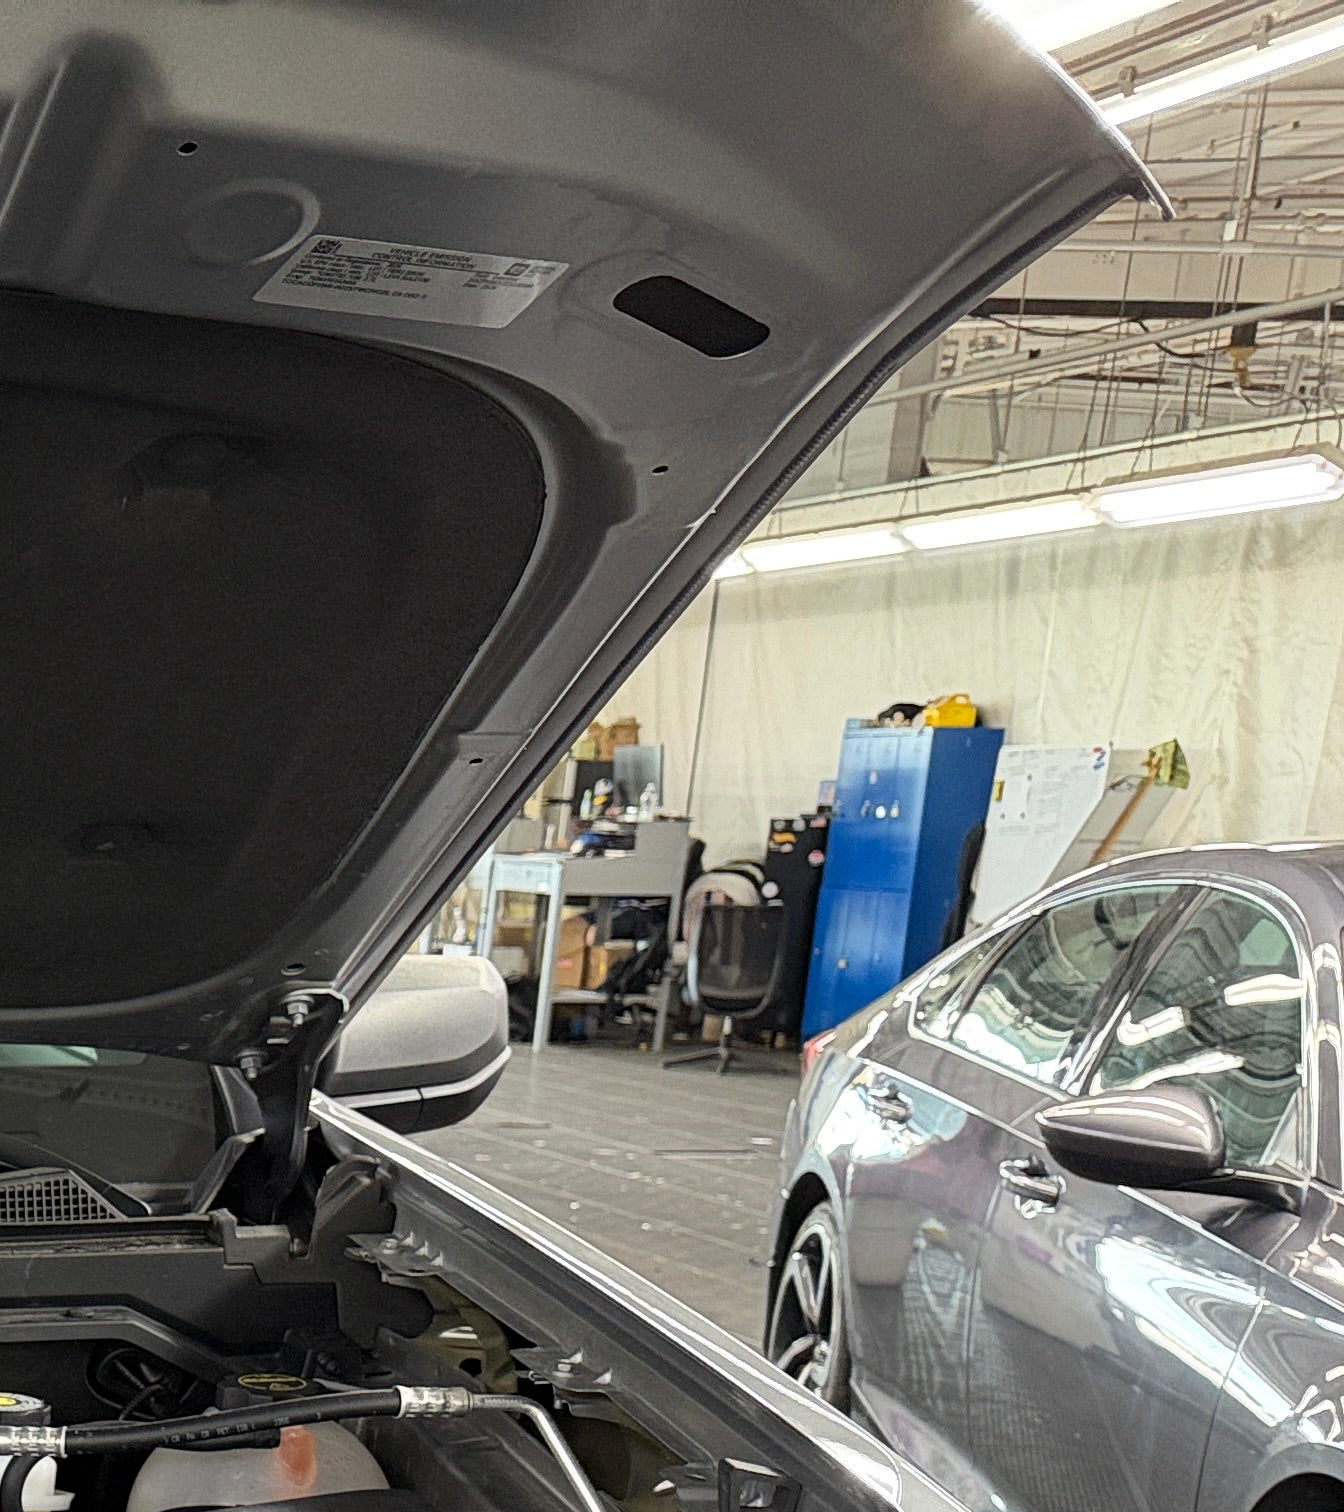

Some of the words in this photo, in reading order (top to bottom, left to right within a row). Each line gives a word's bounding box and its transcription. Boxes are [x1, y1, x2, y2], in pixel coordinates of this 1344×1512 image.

[372, 252, 413, 262] CONTROL
[415, 258, 476, 269] INFORMATION
[390, 248, 427, 257] VEHICLE
[429, 252, 472, 263] EMISSION
